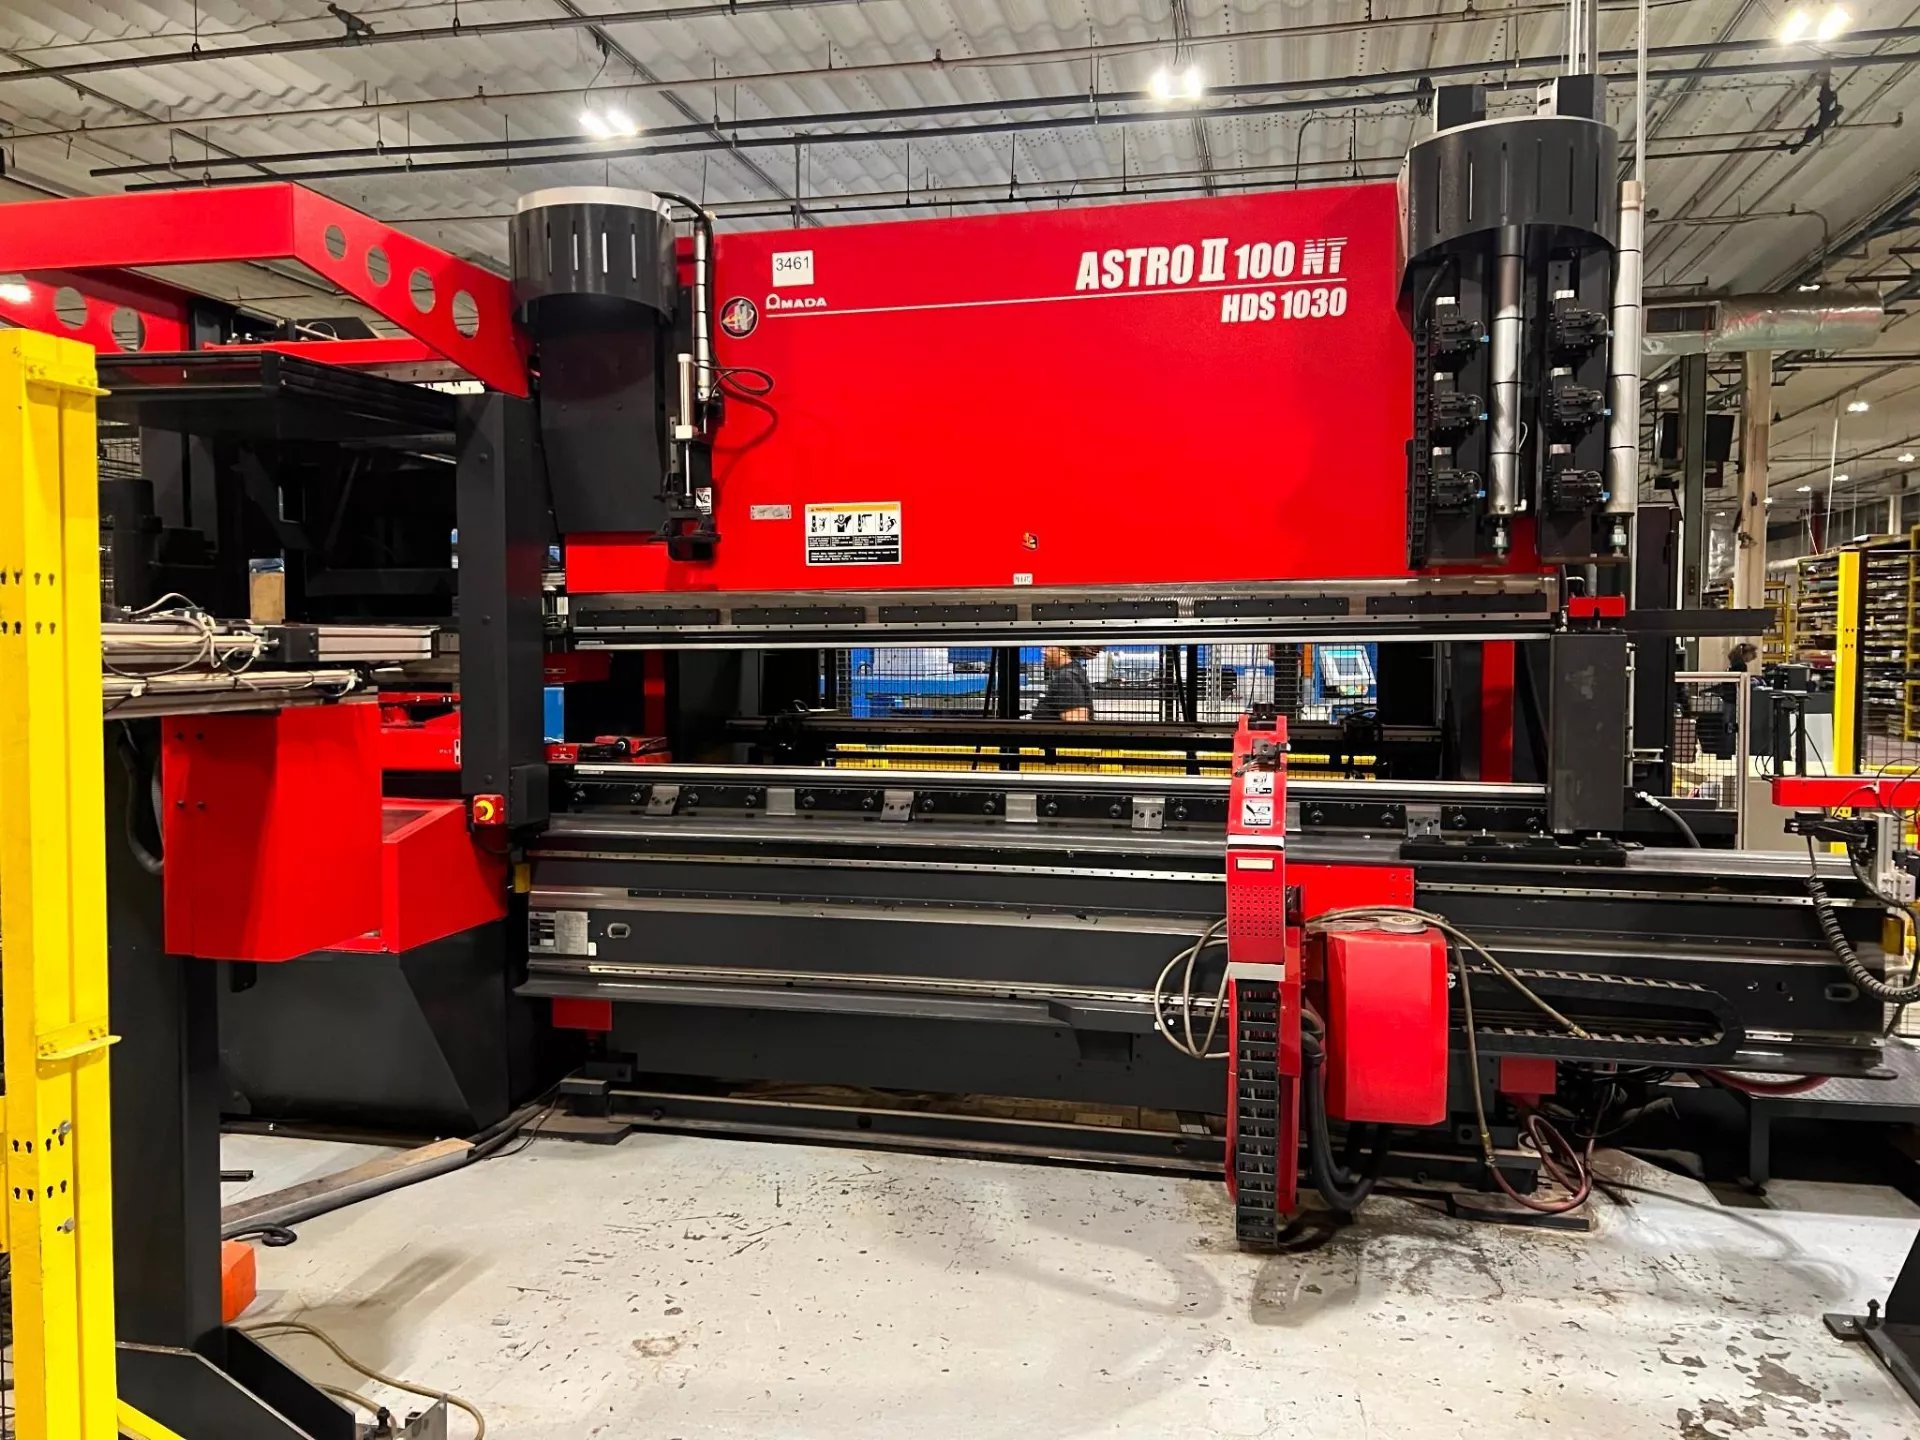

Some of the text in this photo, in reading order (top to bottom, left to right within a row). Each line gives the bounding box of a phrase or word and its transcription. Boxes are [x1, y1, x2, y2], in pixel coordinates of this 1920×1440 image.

[775, 256, 809, 271] 3461
[1075, 243, 1195, 290] ASTRO
[1234, 240, 1296, 281] 100
[1302, 236, 1348, 276] NT
[766, 293, 827, 309] AMADA
[1220, 287, 1348, 323] HDS 1030
